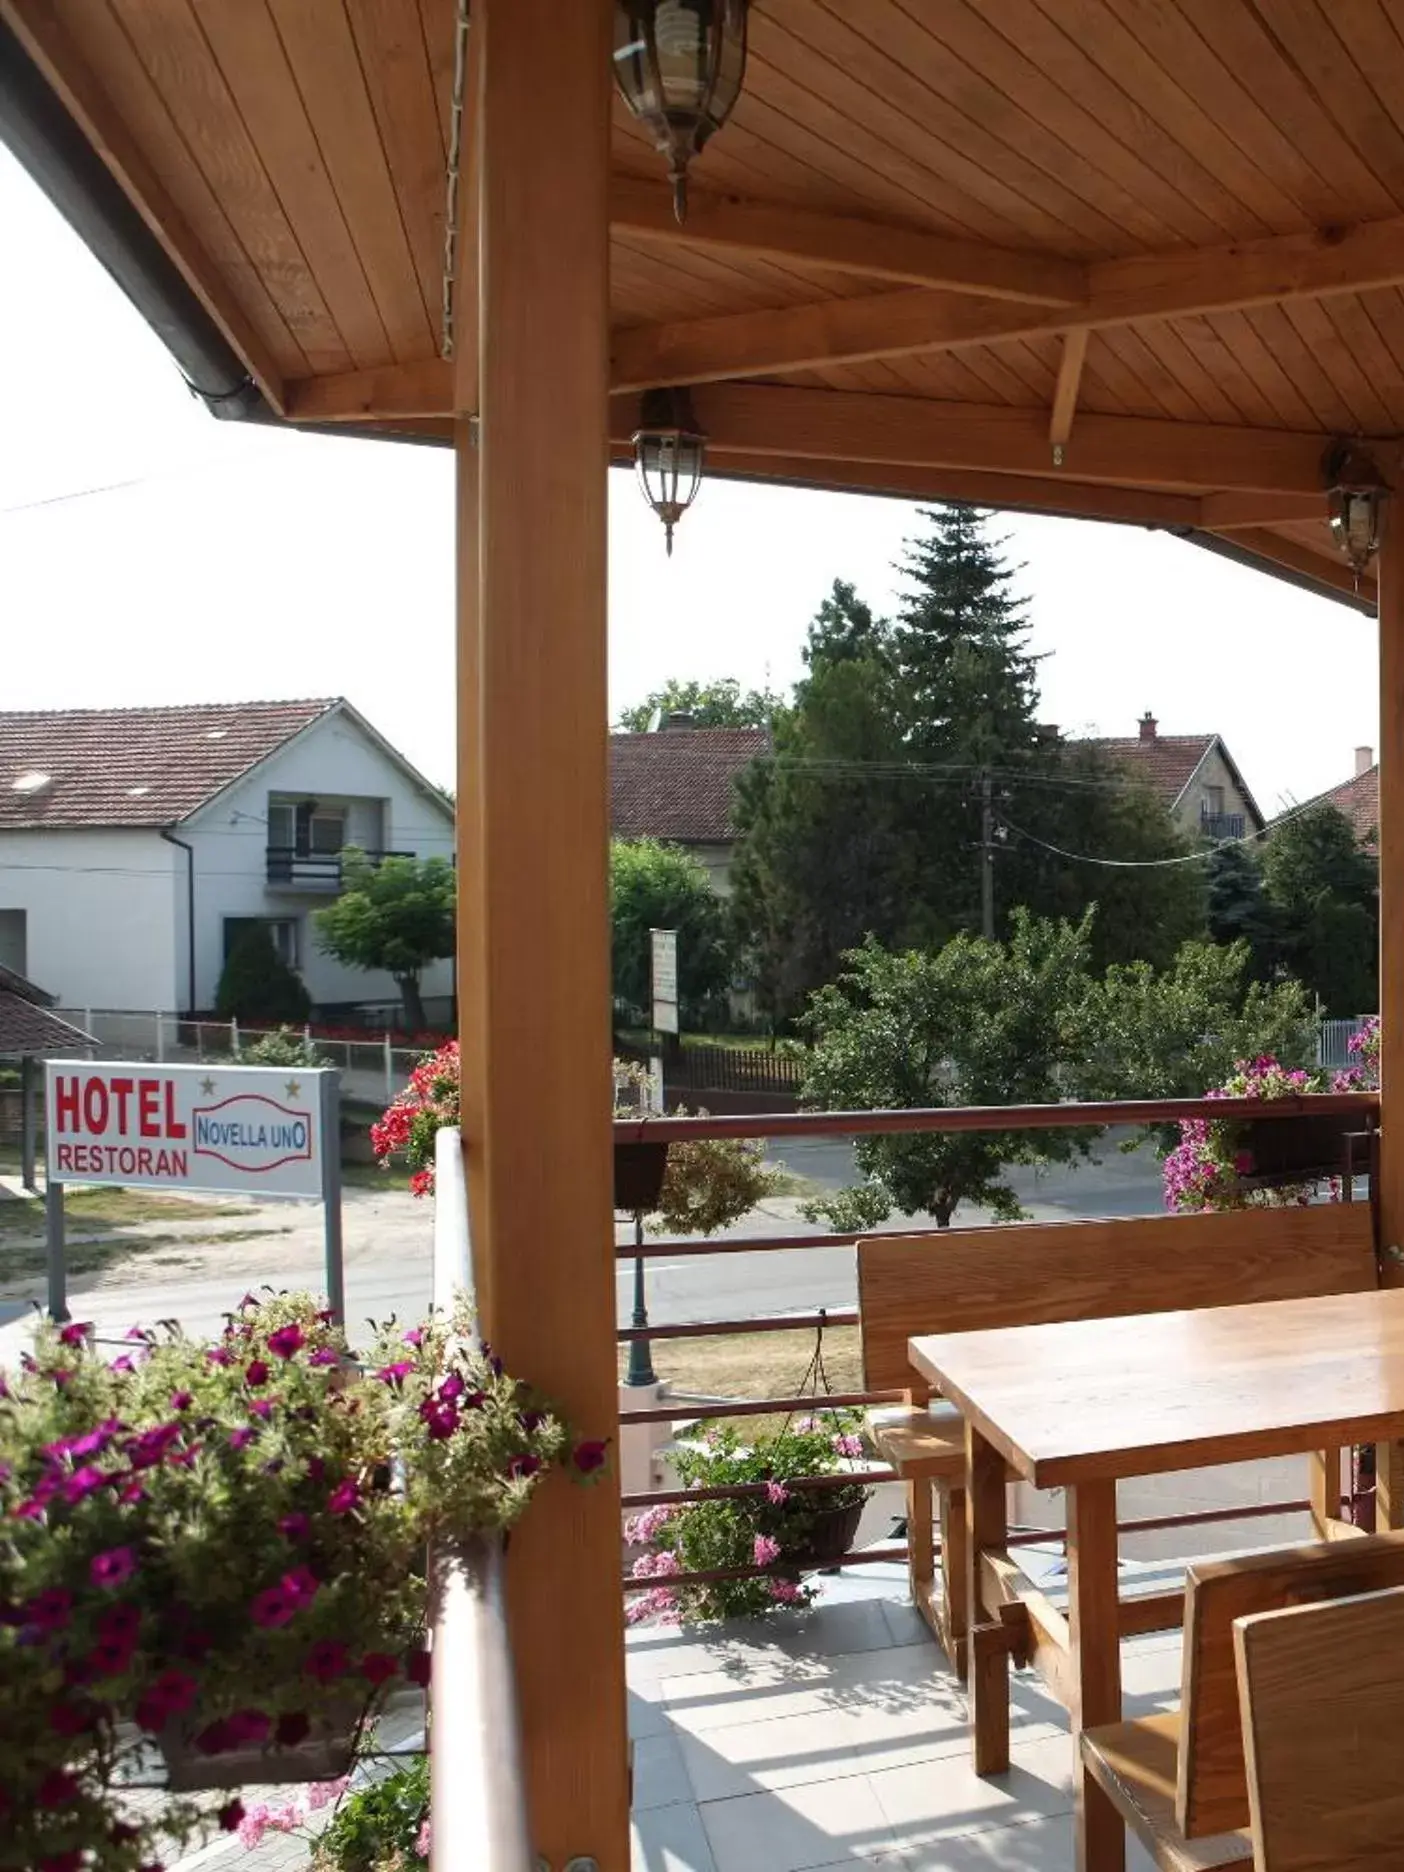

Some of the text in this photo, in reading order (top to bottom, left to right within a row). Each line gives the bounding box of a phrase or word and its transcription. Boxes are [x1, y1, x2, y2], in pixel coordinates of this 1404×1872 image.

[55, 1076, 186, 1139] HOTEL
[198, 1118, 306, 1149] NOVELLA UNO
[57, 1143, 188, 1177] RESTORAN
